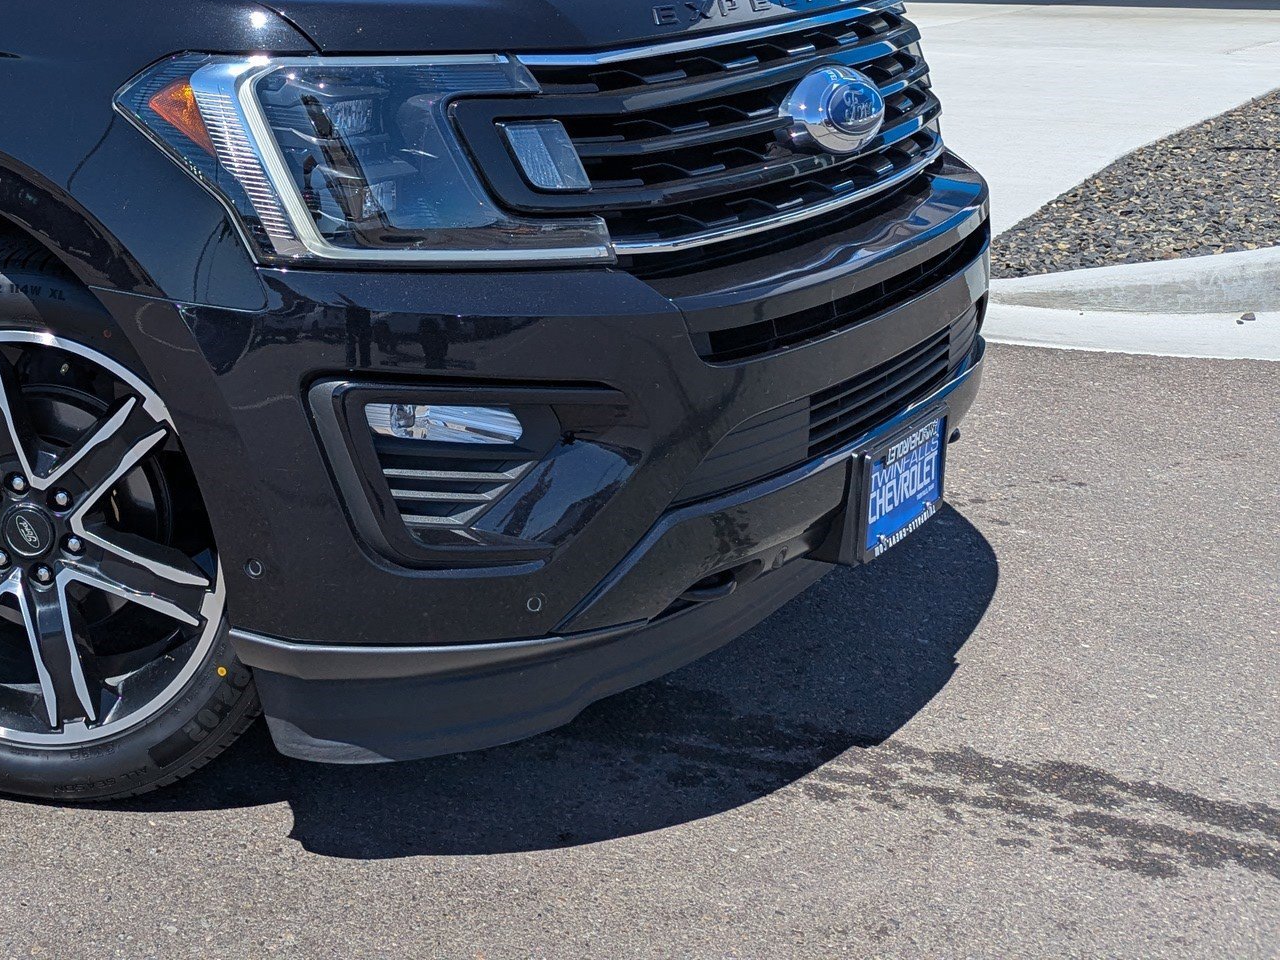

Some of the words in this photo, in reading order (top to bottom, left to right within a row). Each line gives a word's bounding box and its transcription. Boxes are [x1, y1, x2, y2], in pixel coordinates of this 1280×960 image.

[842, 88, 876, 125] Ford
[48, 287, 67, 302] XL
[871, 433, 940, 492] TWINFALLS
[868, 450, 938, 525] CHEVROLET
